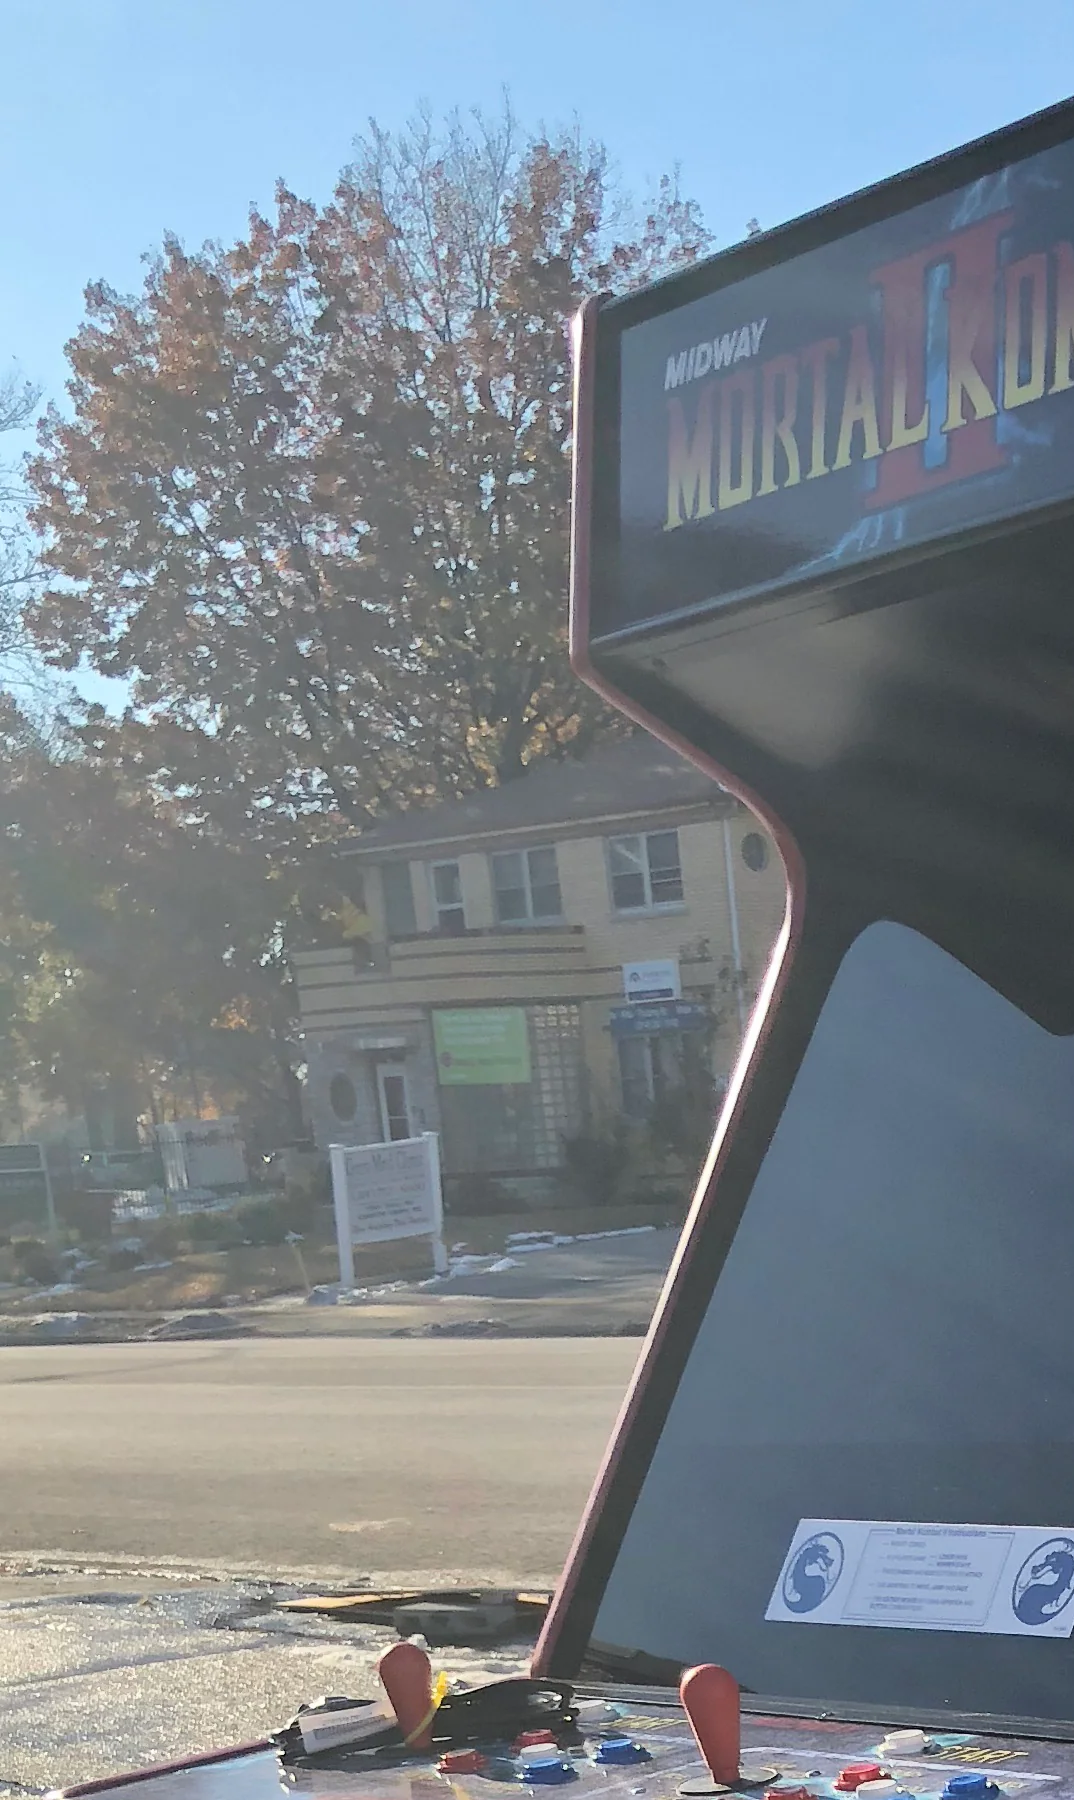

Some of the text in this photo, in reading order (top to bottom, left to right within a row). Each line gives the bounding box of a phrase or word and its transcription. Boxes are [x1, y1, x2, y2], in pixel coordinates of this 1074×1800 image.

[664, 318, 767, 390] MIDWAY
[663, 312, 929, 532] MORTAL
[923, 1745, 1029, 1765] START
